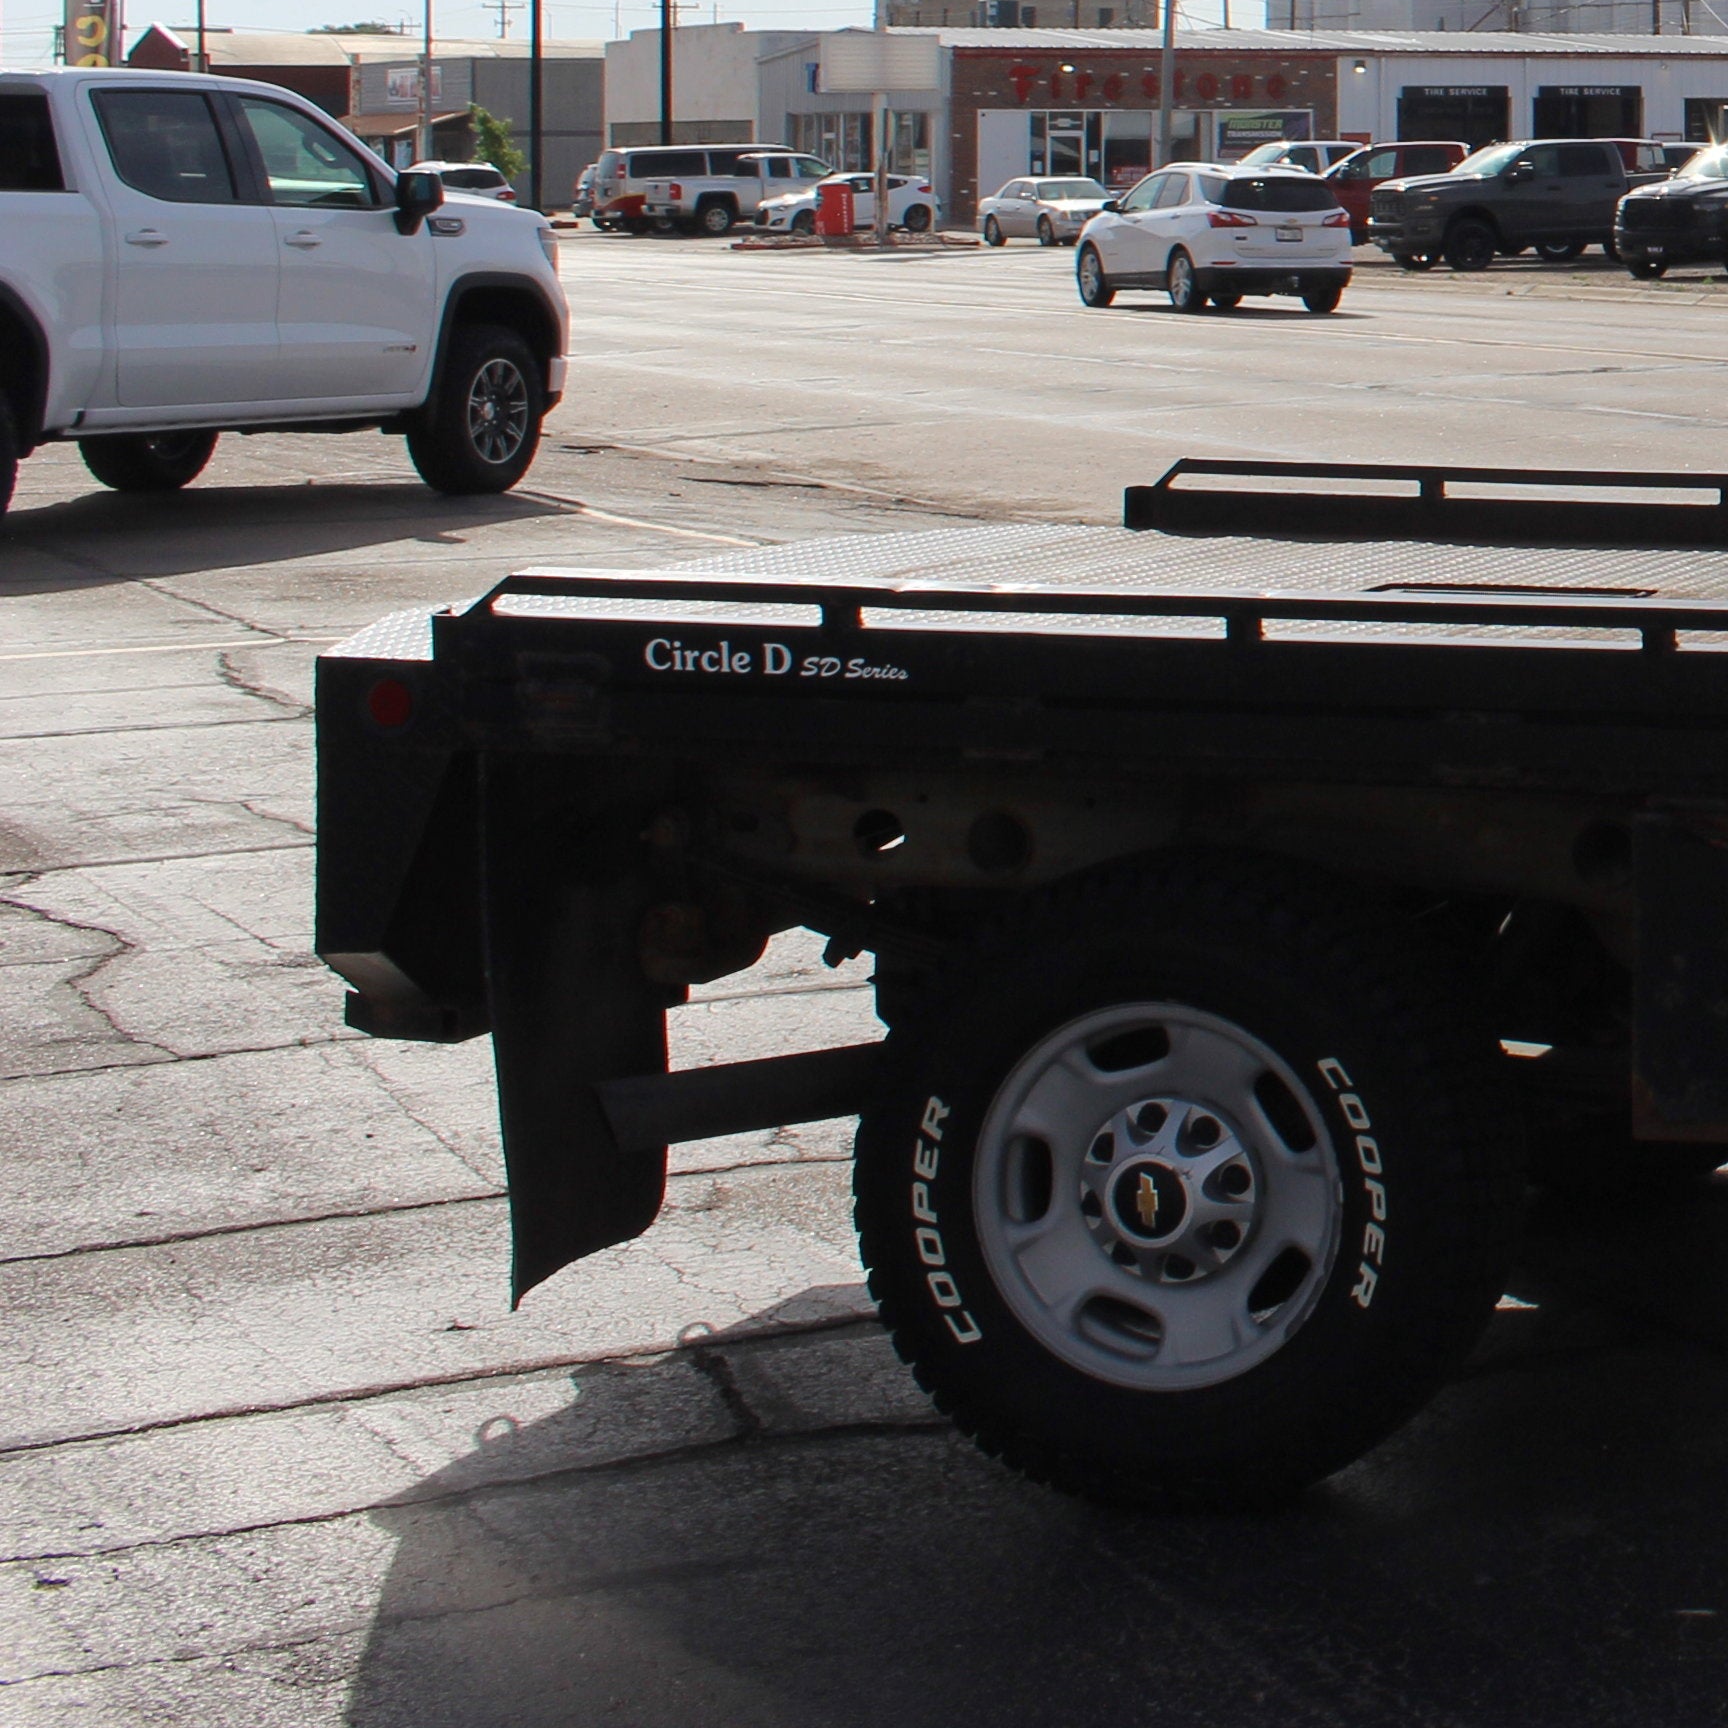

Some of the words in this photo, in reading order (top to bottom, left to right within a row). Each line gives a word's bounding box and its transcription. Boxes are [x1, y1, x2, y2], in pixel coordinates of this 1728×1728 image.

[1008, 65, 1287, 104] Firestone
[1424, 87, 1445, 97] TIRE
[1449, 87, 1488, 97] SERVICE
[1560, 87, 1579, 97] TIRE
[1583, 87, 1622, 97] SERVICE
[644, 638, 751, 672] Circle
[763, 643, 792, 675] D
[801, 656, 842, 678] SD
[844, 658, 909, 681] Series
[1317, 1057, 1387, 1309] COOPER
[912, 1095, 983, 1344] COOPER
